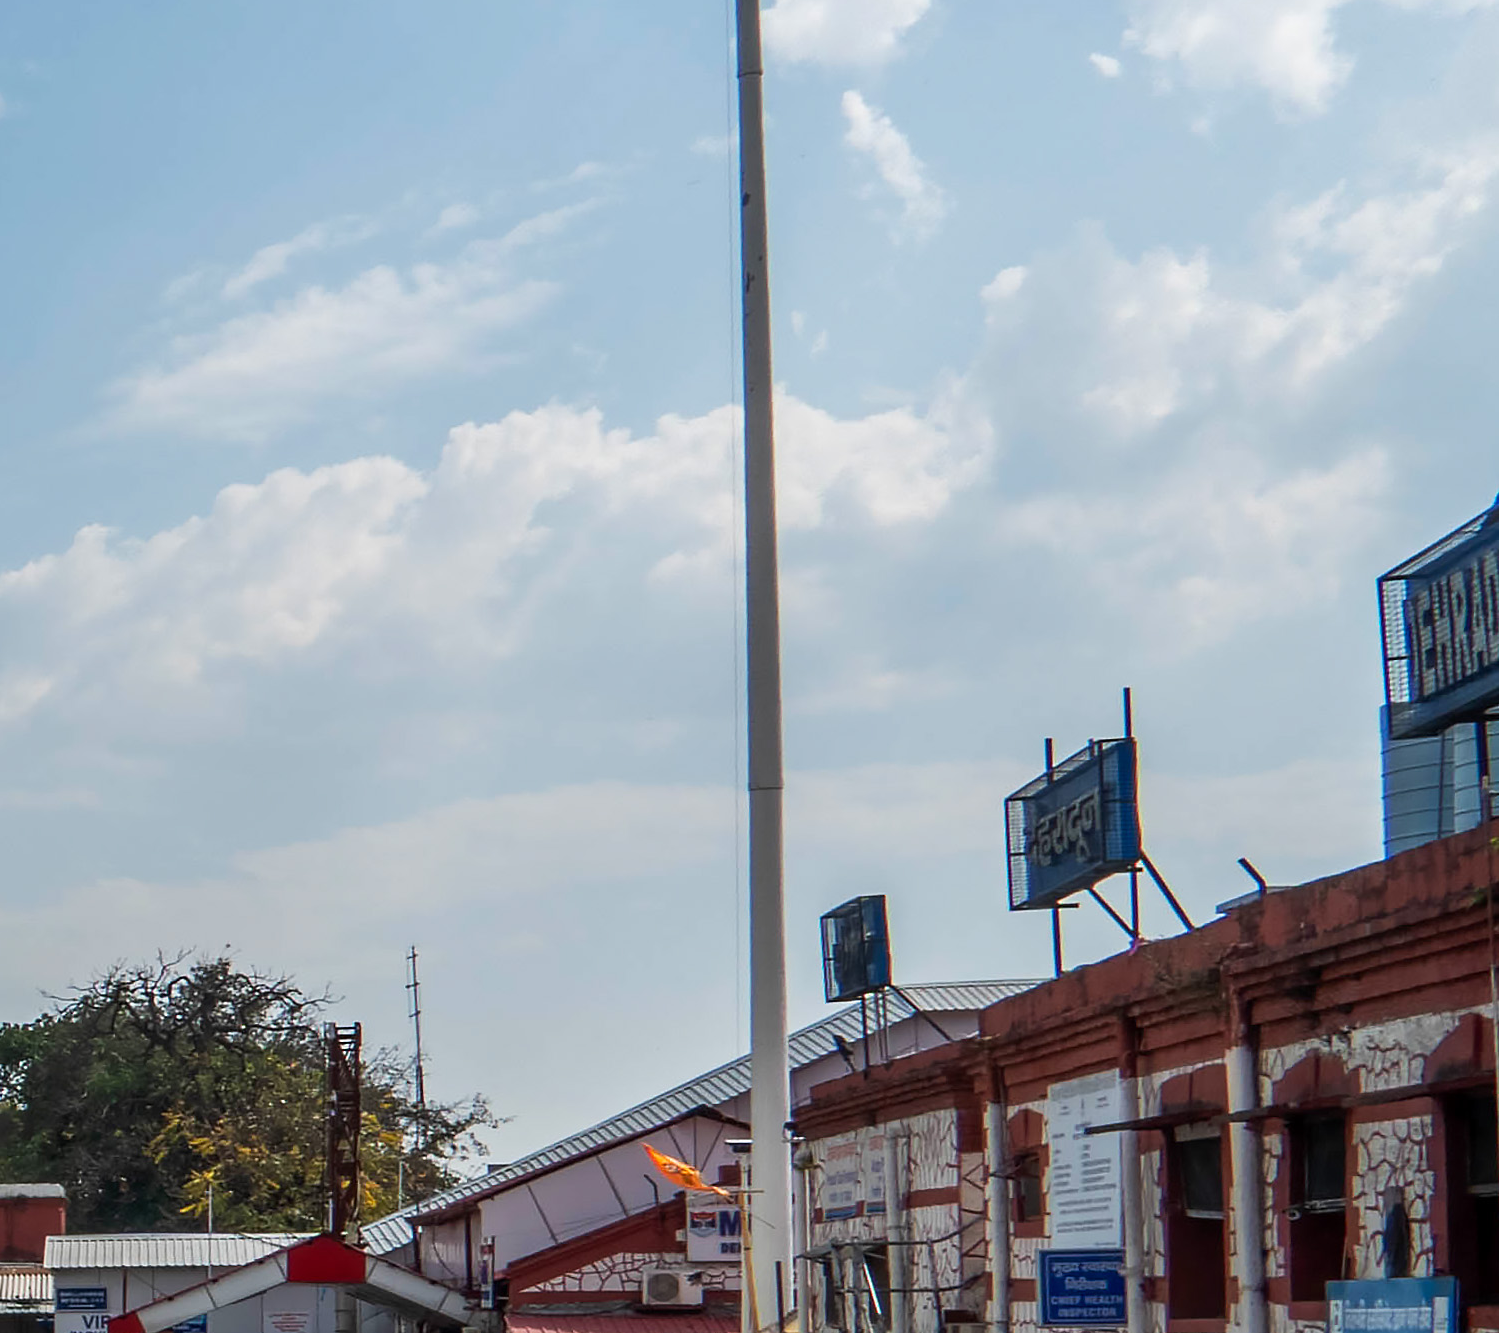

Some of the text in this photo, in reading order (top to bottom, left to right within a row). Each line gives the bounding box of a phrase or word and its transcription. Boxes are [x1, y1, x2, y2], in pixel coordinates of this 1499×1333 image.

[1051, 1295, 1123, 1306] CHIEF HEALTH
[1058, 1306, 1116, 1318] INSPECTOR
